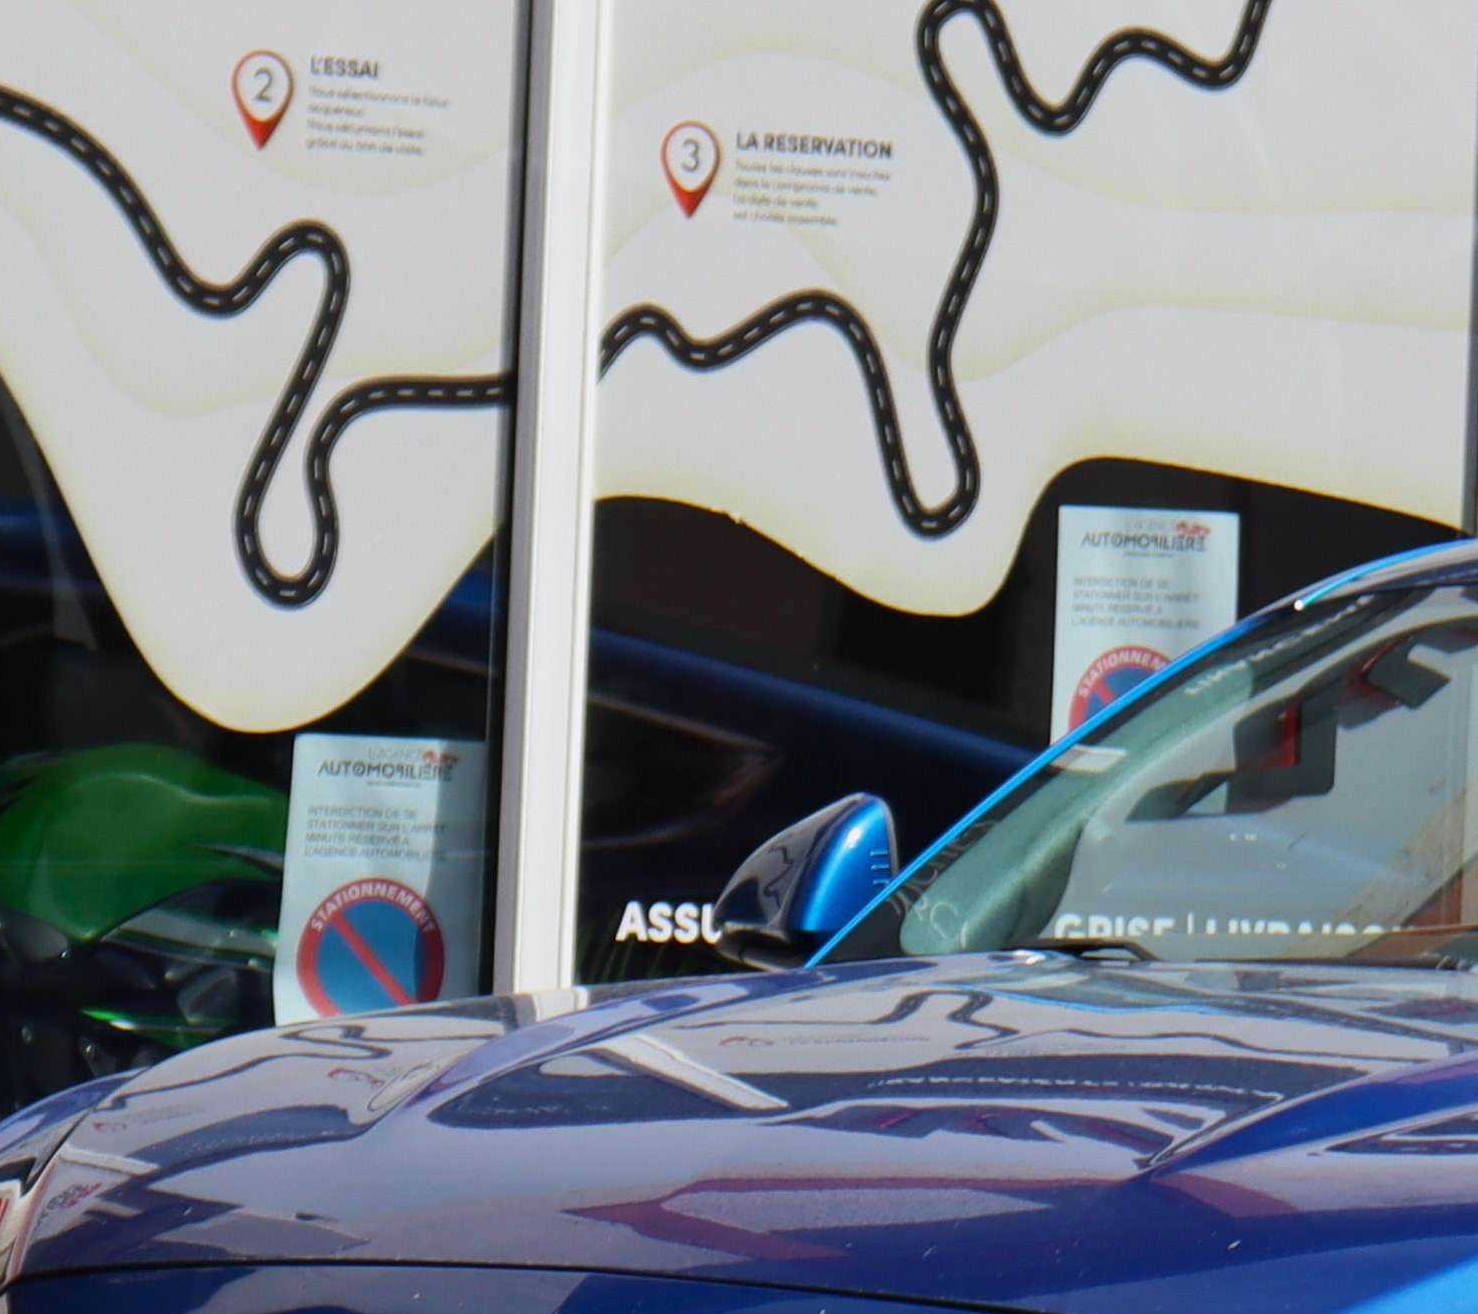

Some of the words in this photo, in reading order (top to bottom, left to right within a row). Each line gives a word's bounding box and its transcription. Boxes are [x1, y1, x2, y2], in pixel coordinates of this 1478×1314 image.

[252, 67, 274, 102] 2
[310, 56, 380, 80] L'ESSAI
[681, 139, 700, 172] 3
[737, 131, 758, 151] LA
[763, 134, 892, 159] RESERVATION
[310, 881, 436, 933] STATIONNEMENT
